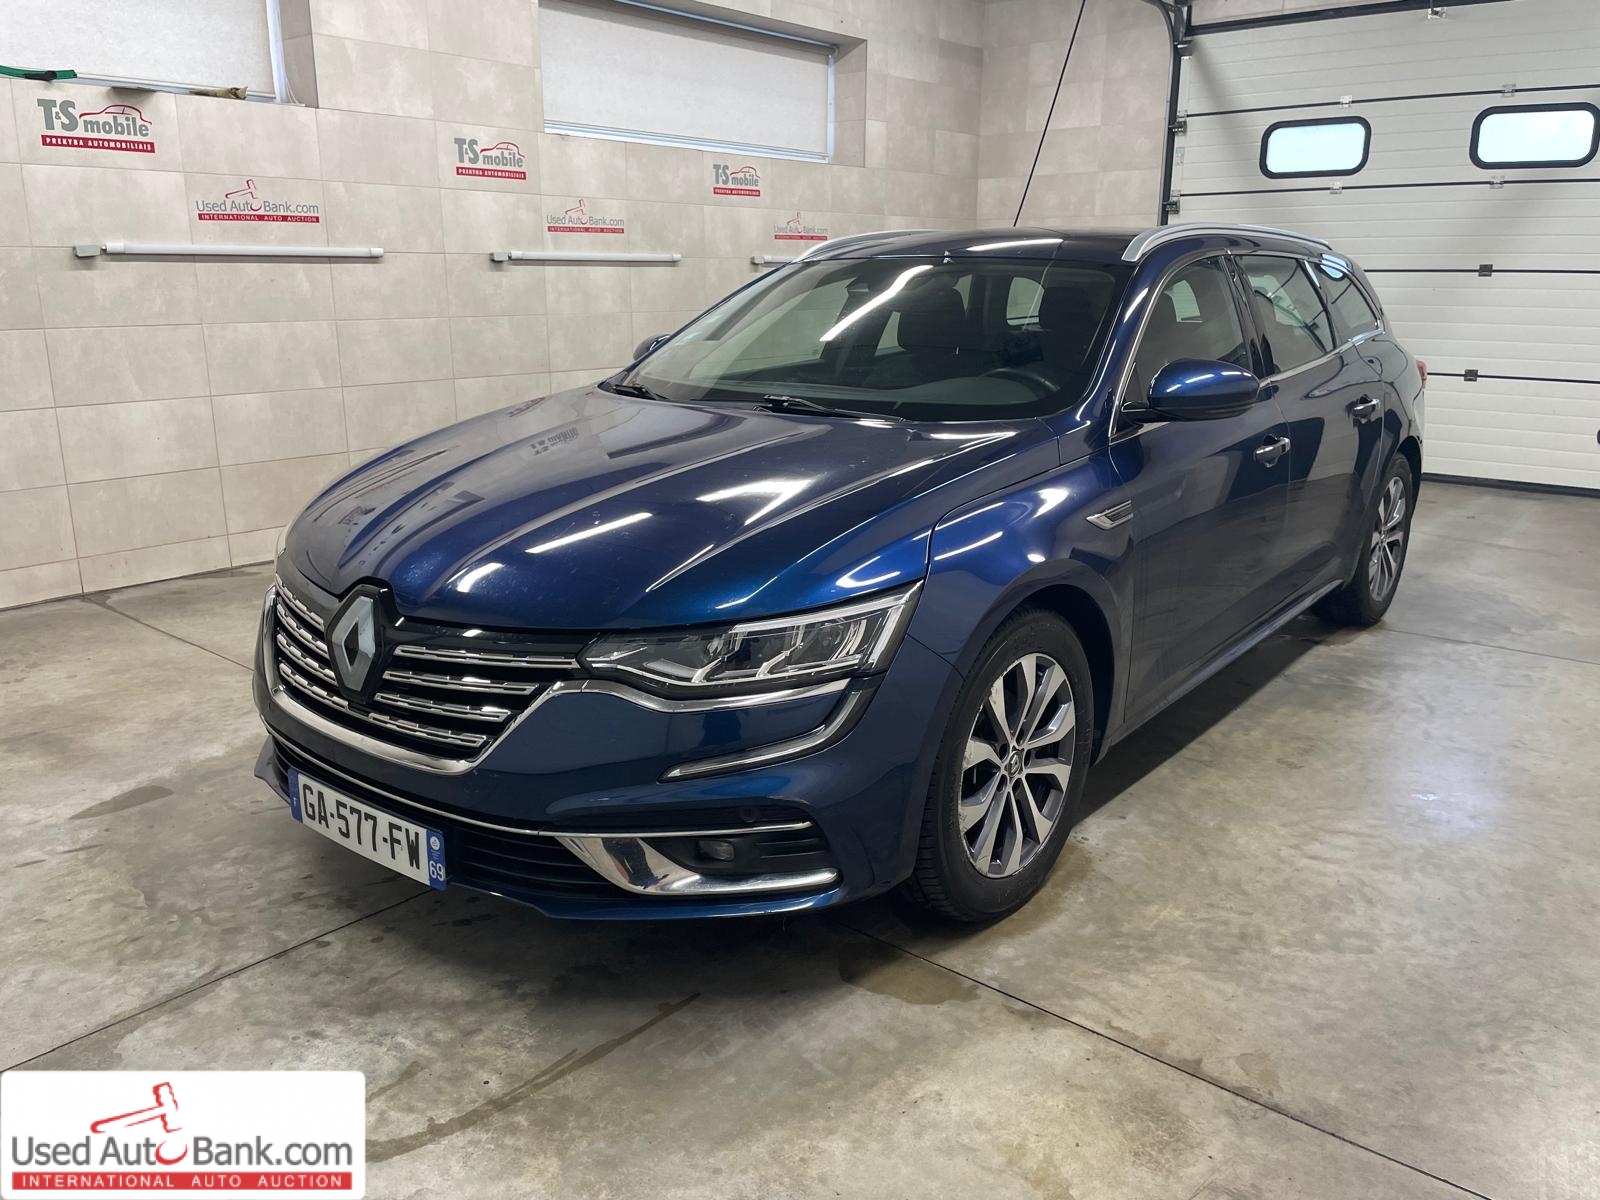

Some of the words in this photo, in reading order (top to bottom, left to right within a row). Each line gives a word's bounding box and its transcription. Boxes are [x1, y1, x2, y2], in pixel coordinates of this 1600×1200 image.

[37, 98, 79, 132] T&S
[83, 115, 149, 137] mobile
[46, 137, 84, 146] PREKYBA
[88, 140, 151, 151] AUTOMOBILIAIS
[482, 151, 523, 168] mobile
[731, 174, 759, 187] mobile
[196, 200, 227, 212] Used
[546, 214, 566, 225] Used
[302, 783, 420, 870] GA-577-FW
[429, 860, 444, 881] 69
